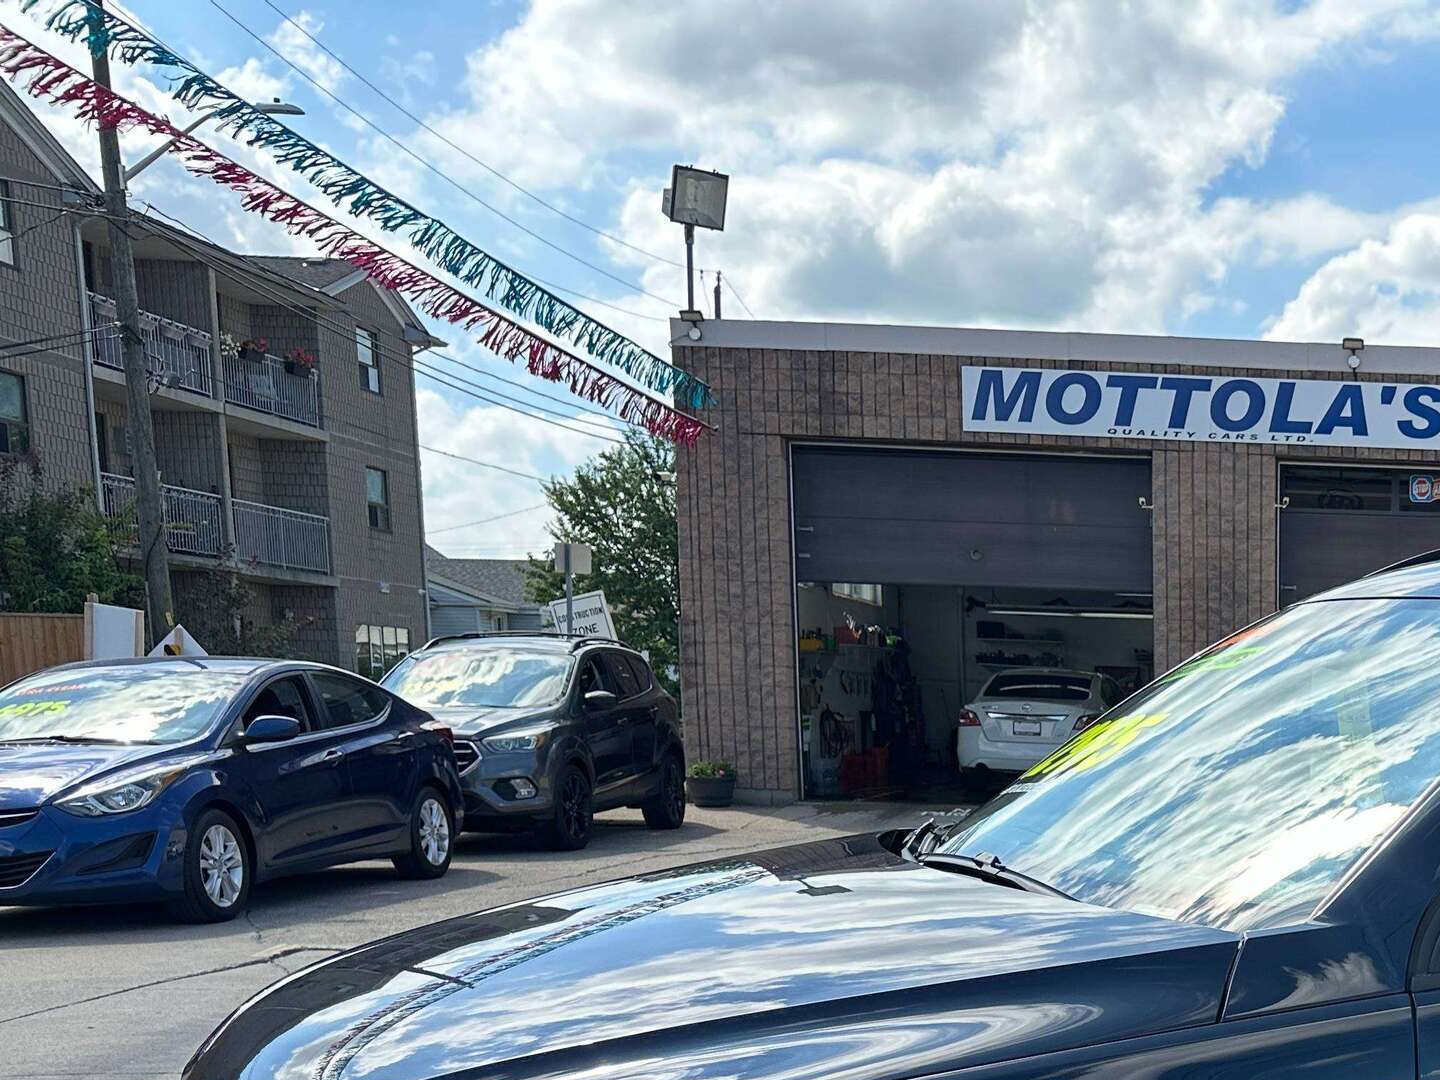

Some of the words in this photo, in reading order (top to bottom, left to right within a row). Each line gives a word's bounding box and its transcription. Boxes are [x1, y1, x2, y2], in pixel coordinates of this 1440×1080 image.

[1107, 427, 1197, 438] QUALITY
[1208, 432, 1259, 441] CARS
[1270, 434, 1314, 443] LTD.
